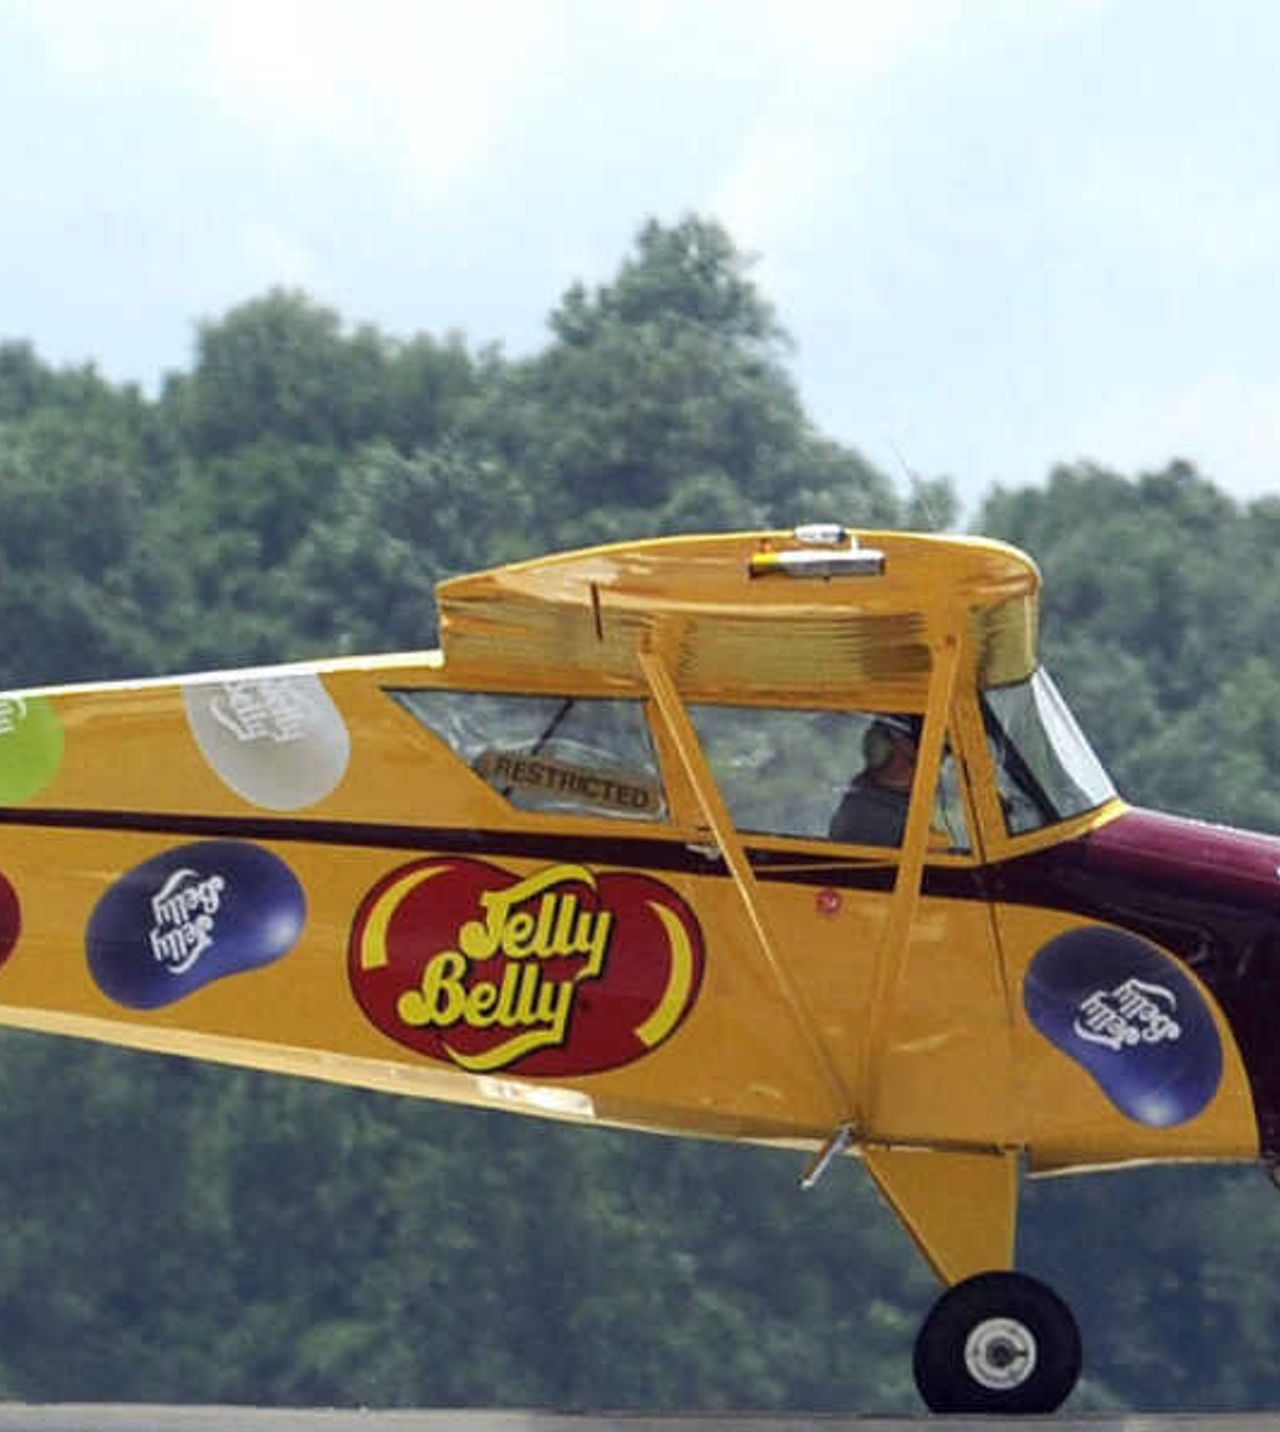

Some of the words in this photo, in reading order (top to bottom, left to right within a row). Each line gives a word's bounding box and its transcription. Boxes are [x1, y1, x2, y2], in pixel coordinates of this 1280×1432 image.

[497, 756, 651, 808] RESTRICTED
[151, 868, 225, 925] Belly
[459, 863, 611, 980] Jelly
[149, 914, 214, 975] Jelly
[397, 951, 573, 1071] Belly
[1074, 989, 1140, 1050] Jelly
[1111, 977, 1181, 1043] Belly
